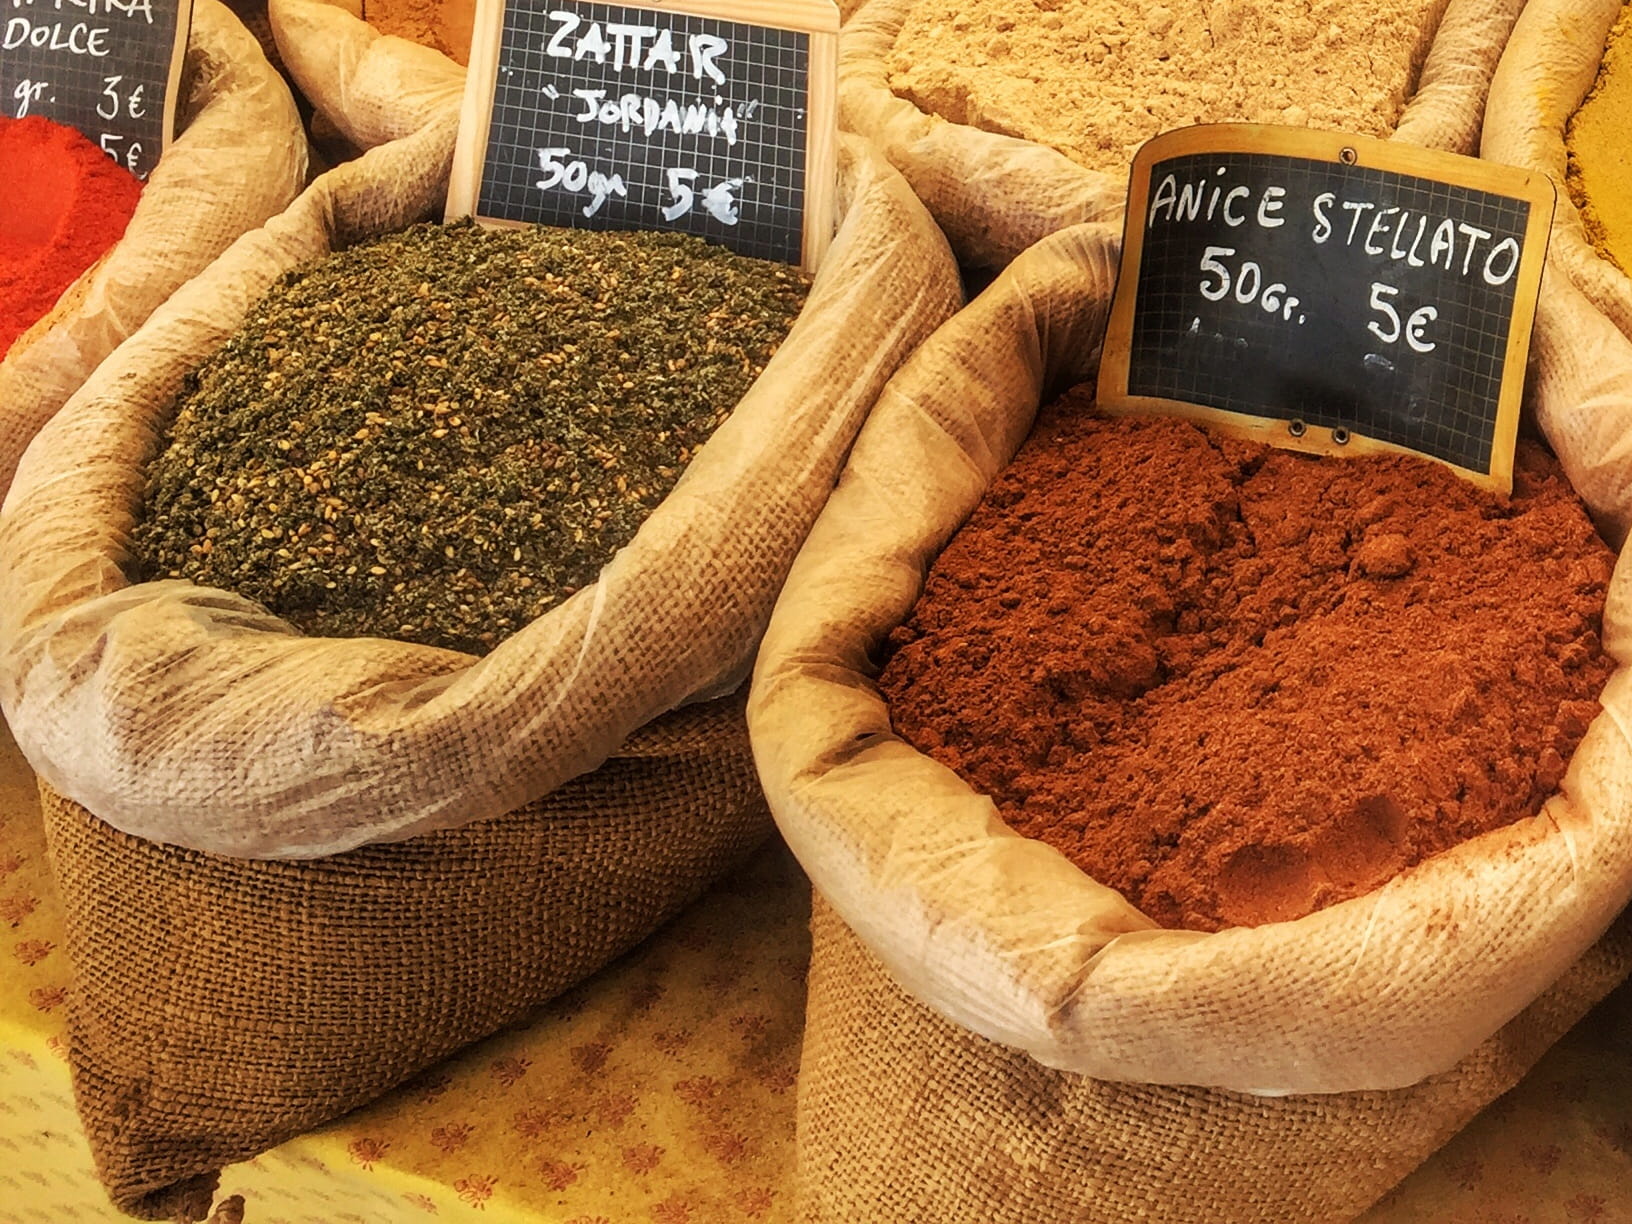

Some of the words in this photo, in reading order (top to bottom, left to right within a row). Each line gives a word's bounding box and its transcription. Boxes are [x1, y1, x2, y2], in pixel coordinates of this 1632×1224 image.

[2, 16, 110, 57] DOLCE
[545, 9, 728, 86] ZATTAR
[95, 75, 122, 121] 3
[1149, 166, 1288, 229] ANICE
[1311, 192, 1520, 287] STELLATO
